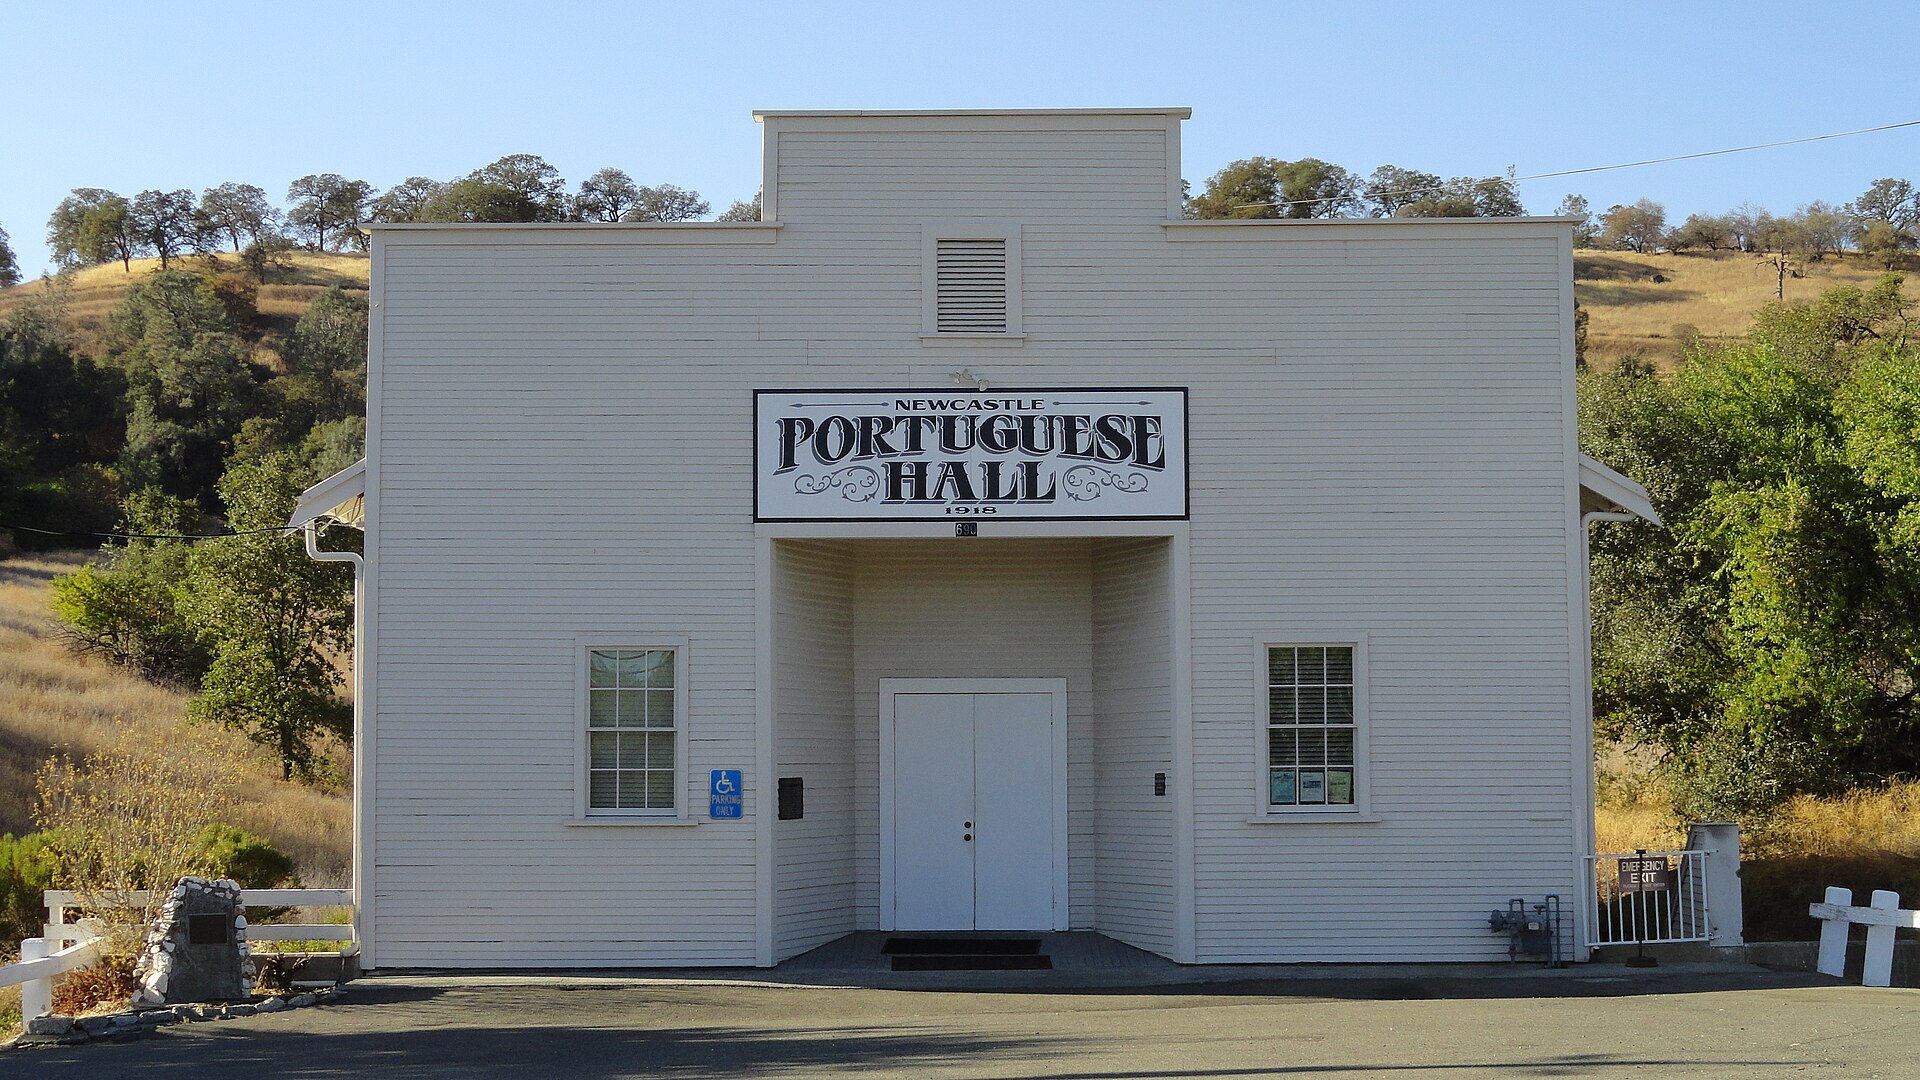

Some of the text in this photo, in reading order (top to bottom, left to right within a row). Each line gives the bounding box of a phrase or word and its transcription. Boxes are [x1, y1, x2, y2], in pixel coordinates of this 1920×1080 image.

[895, 399, 1045, 411] NEWCASTLE
[773, 415, 1166, 475] PORTUGUESE
[880, 461, 1057, 505] HALL
[945, 506, 999, 515] 1918
[956, 523, 977, 536] 690
[711, 794, 741, 804] PARKING
[715, 805, 734, 816] ONLY
[1621, 860, 1664, 872] EMERGENCY
[1630, 872, 1657, 883] EXIT
